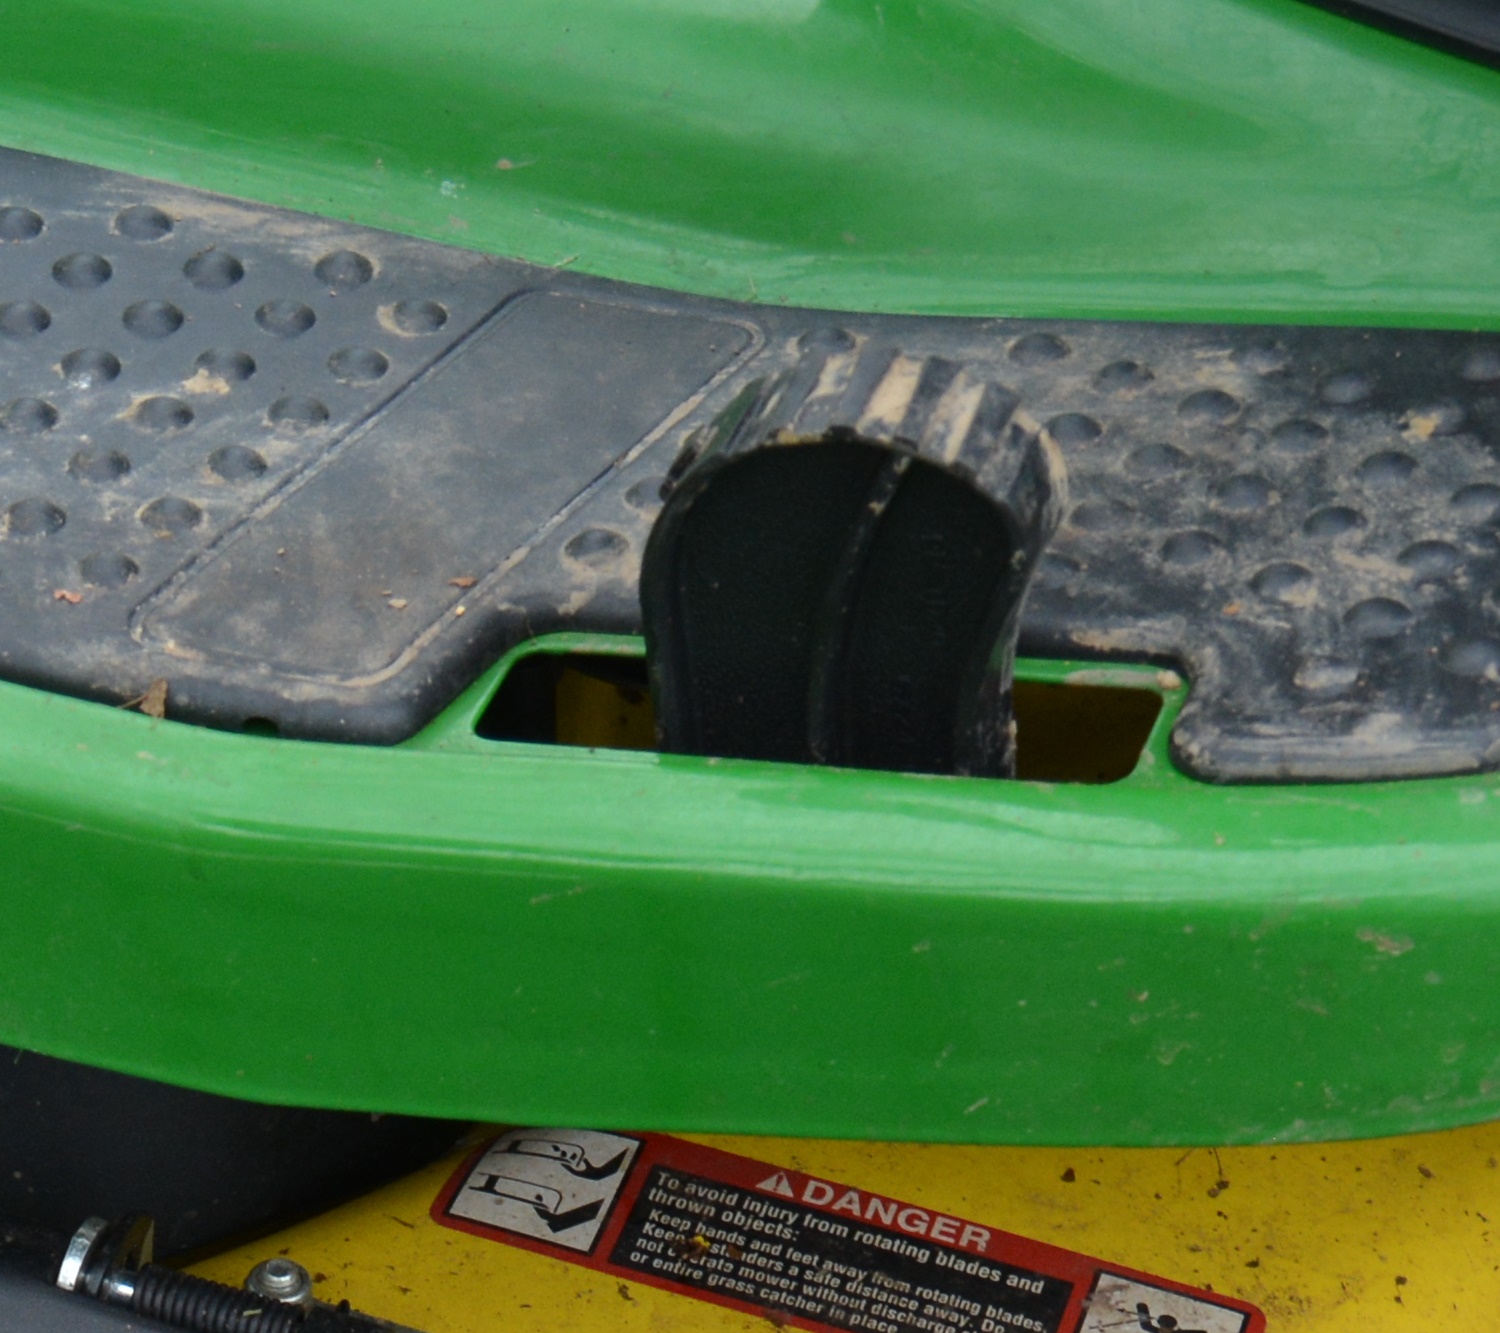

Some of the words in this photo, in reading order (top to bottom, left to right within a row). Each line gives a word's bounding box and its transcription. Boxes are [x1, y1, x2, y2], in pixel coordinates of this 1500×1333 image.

[648, 1188, 715, 1216] thrown
[658, 1172, 679, 1189] To
[684, 1183, 738, 1205] avoid
[742, 1196, 798, 1224] injury
[803, 1213, 848, 1237] from
[853, 1231, 929, 1263] rotating
[935, 1251, 1001, 1281] blades
[1006, 1274, 1044, 1293] and
[802, 1180, 989, 1251] DANGER
[630, 1251, 648, 1263] or
[652, 1258, 702, 1279] entire
[707, 1273, 755, 1293] grass
[759, 1288, 823, 1312] catcher
[828, 1305, 844, 1319] in
[635, 1238, 663, 1253] not
[738, 1266, 797, 1290] mower
[802, 1284, 866, 1310] without
[648, 1208, 691, 1231] Keep
[695, 1222, 745, 1245] hands
[749, 1240, 782, 1255] and
[785, 1247, 818, 1266] feet
[822, 1260, 867, 1282] away
[871, 1271, 910, 1292] from
[915, 1286, 980, 1315] rotating
[788, 1265, 798, 1275] a
[803, 1269, 840, 1287] safe
[845, 1280, 918, 1310] distance
